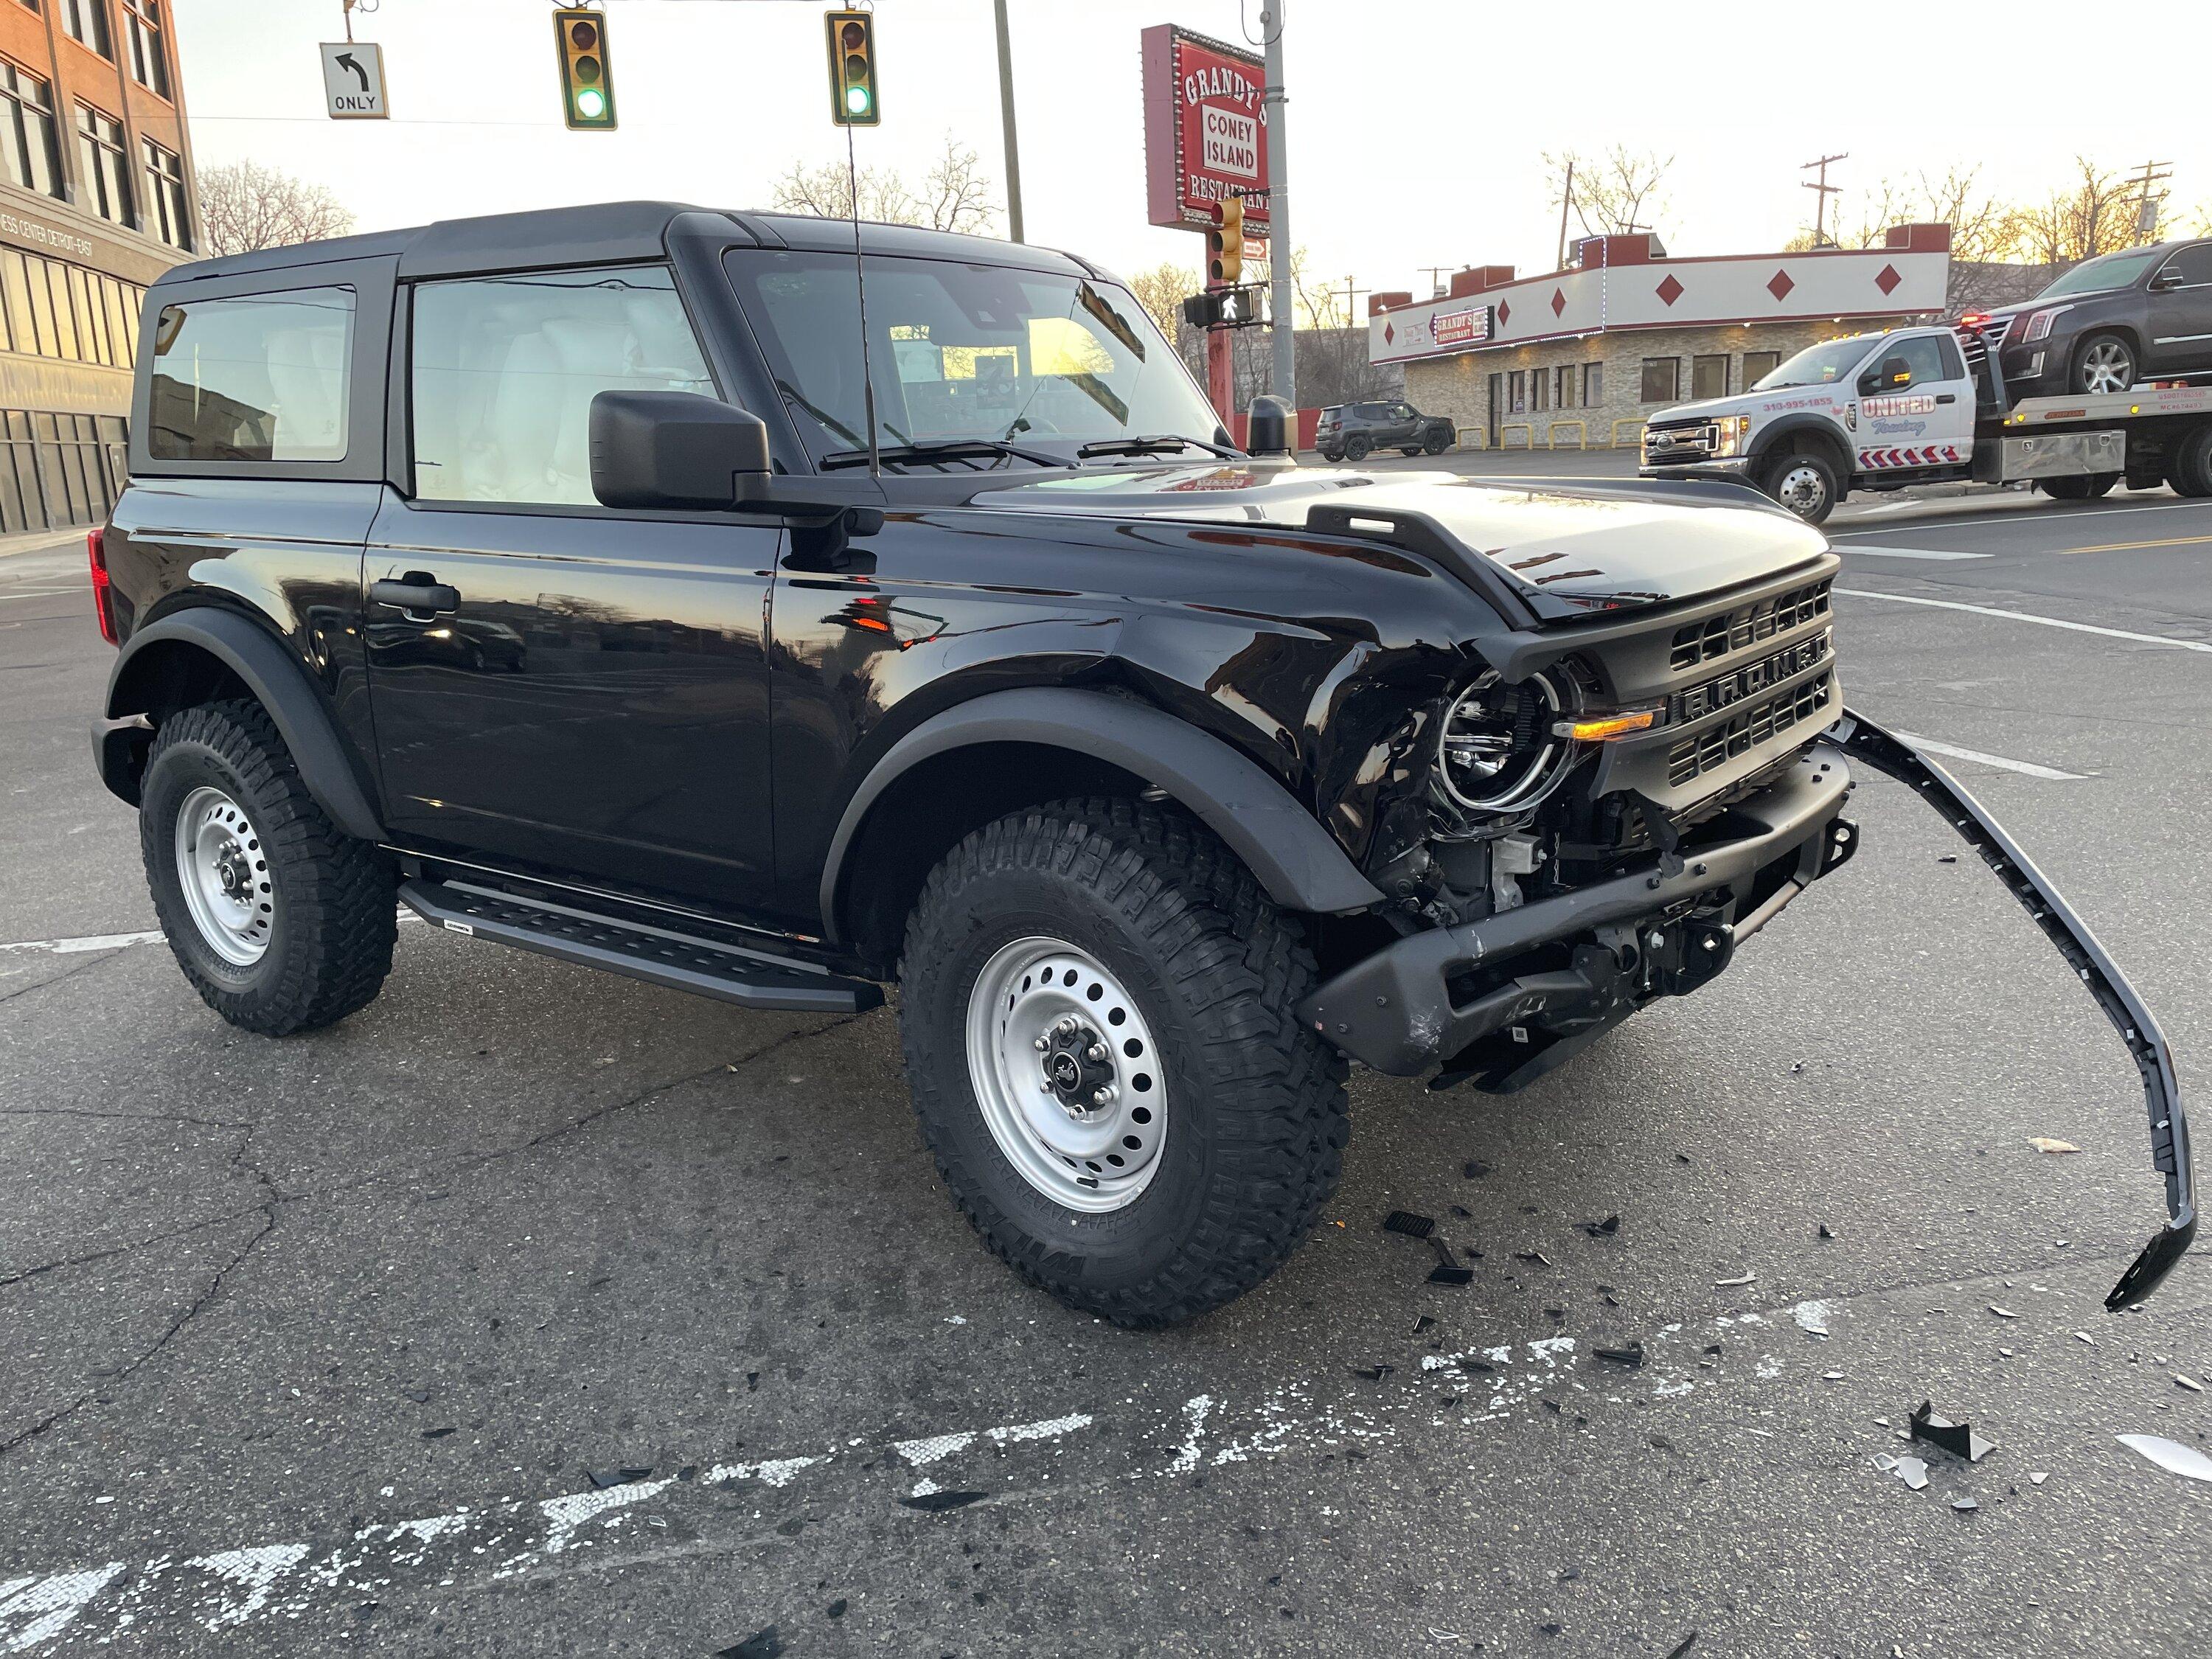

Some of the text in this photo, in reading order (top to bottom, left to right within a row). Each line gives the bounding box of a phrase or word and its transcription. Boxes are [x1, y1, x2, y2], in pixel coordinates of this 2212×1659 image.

[335, 96, 375, 110] ONLY
[1185, 66, 1267, 128] GRANDY'S
[1208, 113, 1251, 143] CONEY
[1207, 139, 1253, 170] ISLAND
[0, 213, 92, 257] ESS CENTER DETROIT-EAST
[1437, 314, 1473, 332] GRANDY'S
[1763, 397, 1833, 411] 313-995-1855
[1862, 394, 1935, 419] UNITED
[1871, 417, 1927, 437] Towing
[1680, 633, 1829, 718] BRONCO
